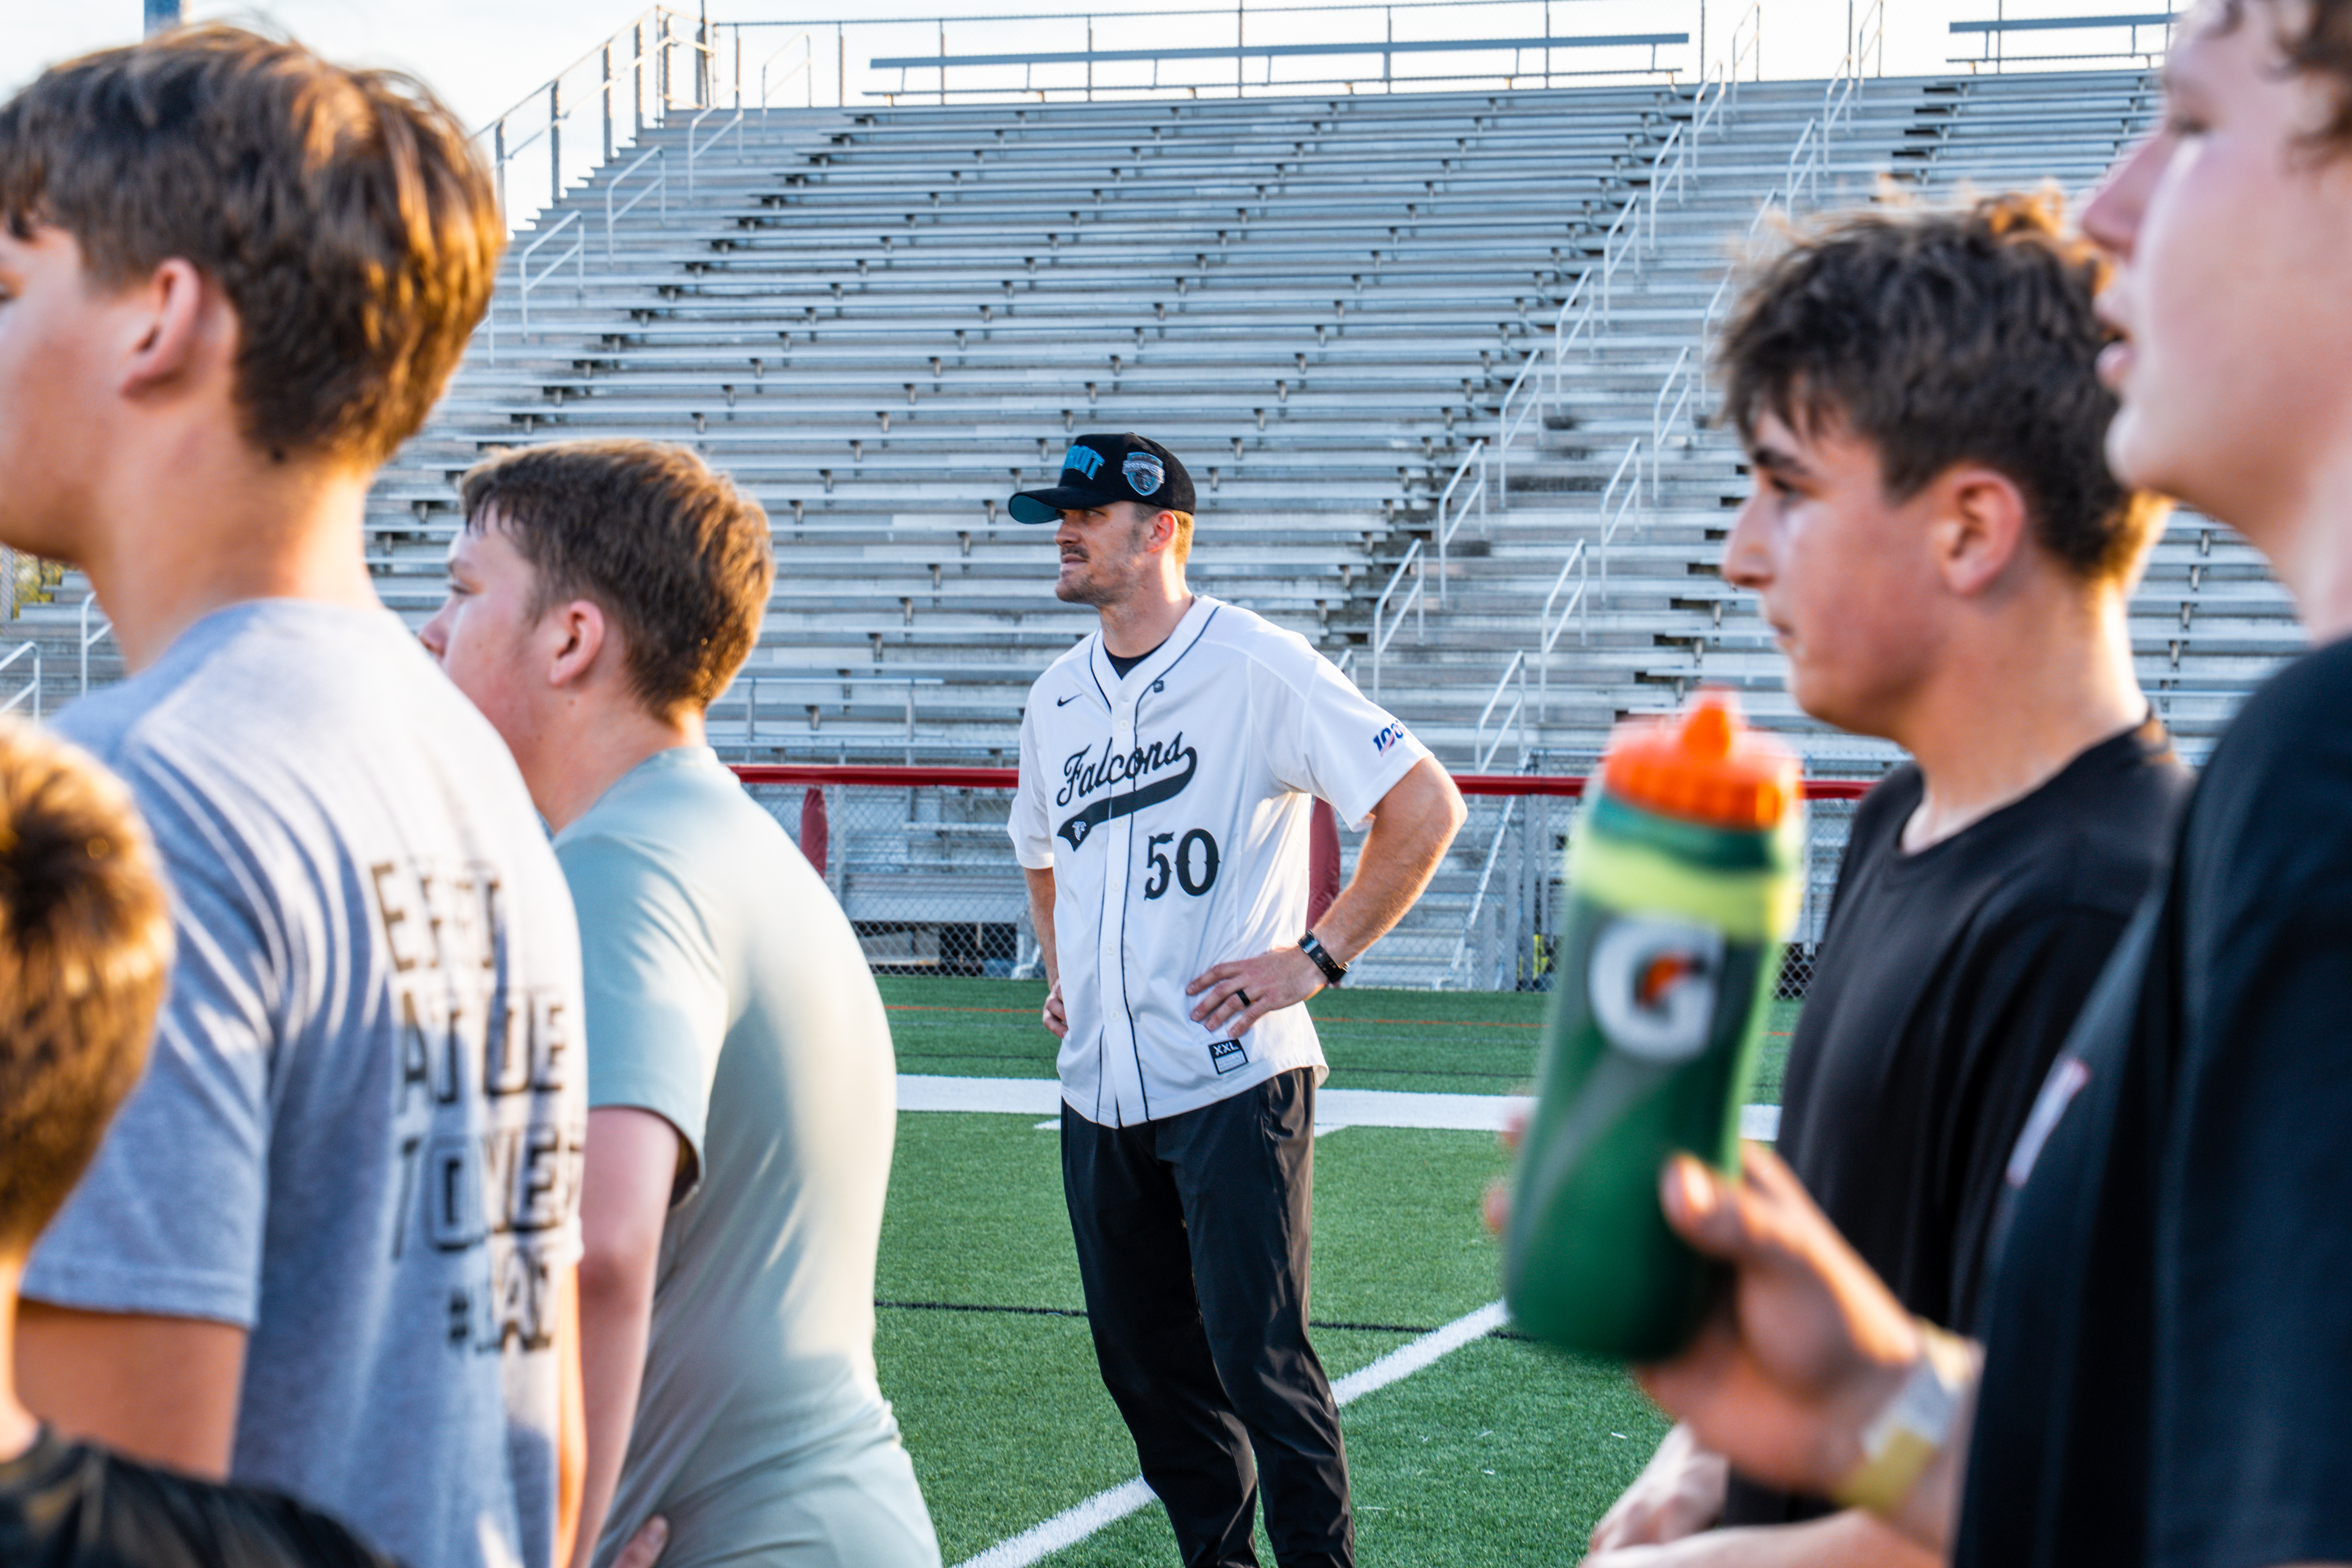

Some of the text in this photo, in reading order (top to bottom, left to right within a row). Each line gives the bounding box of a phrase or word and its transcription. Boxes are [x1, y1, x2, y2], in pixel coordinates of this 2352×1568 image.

[1056, 731, 1186, 806] Falcons
[1144, 828, 1222, 901] 50
[1213, 1041, 1239, 1056] XXL
